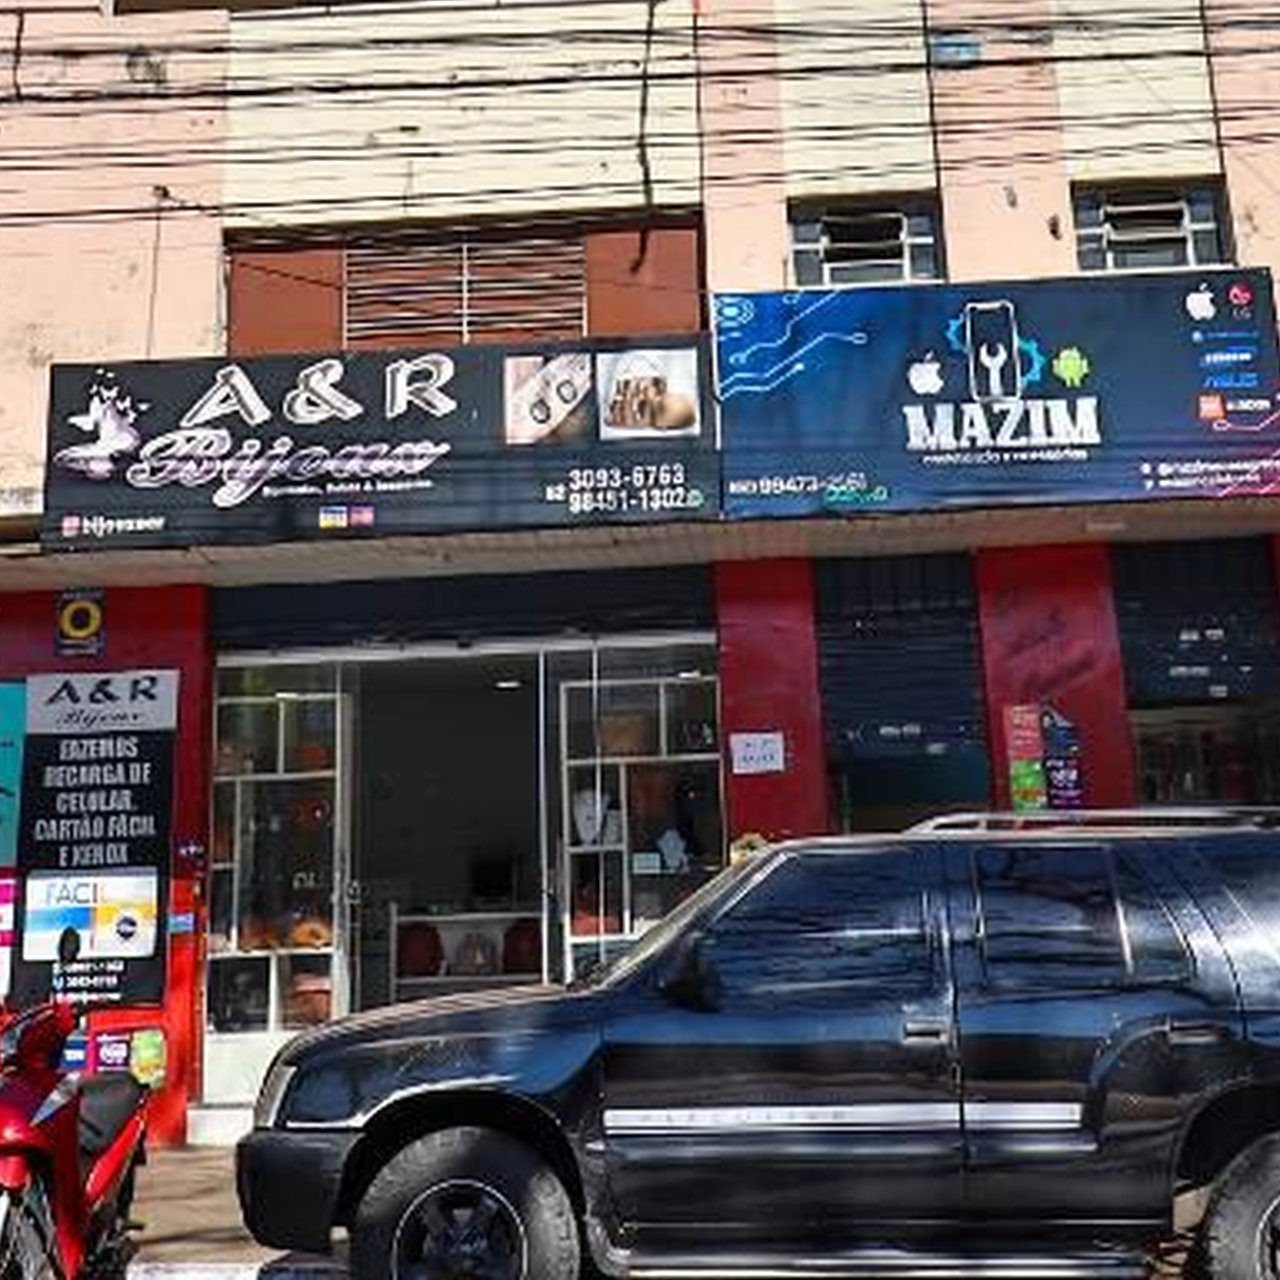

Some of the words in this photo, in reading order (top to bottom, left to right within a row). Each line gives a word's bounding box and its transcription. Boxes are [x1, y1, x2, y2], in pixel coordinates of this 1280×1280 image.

[179, 364, 272, 427] A
[283, 359, 365, 424] &
[385, 354, 460, 419] R
[902, 397, 1102, 451] MAZIM
[45, 680, 82, 706] A
[89, 679, 120, 704] &
[130, 676, 158, 701] R
[59, 737, 139, 761] FAZEMOS
[43, 764, 125, 788] RECARGA
[129, 763, 152, 784] DE
[60, 846, 69, 867] E
